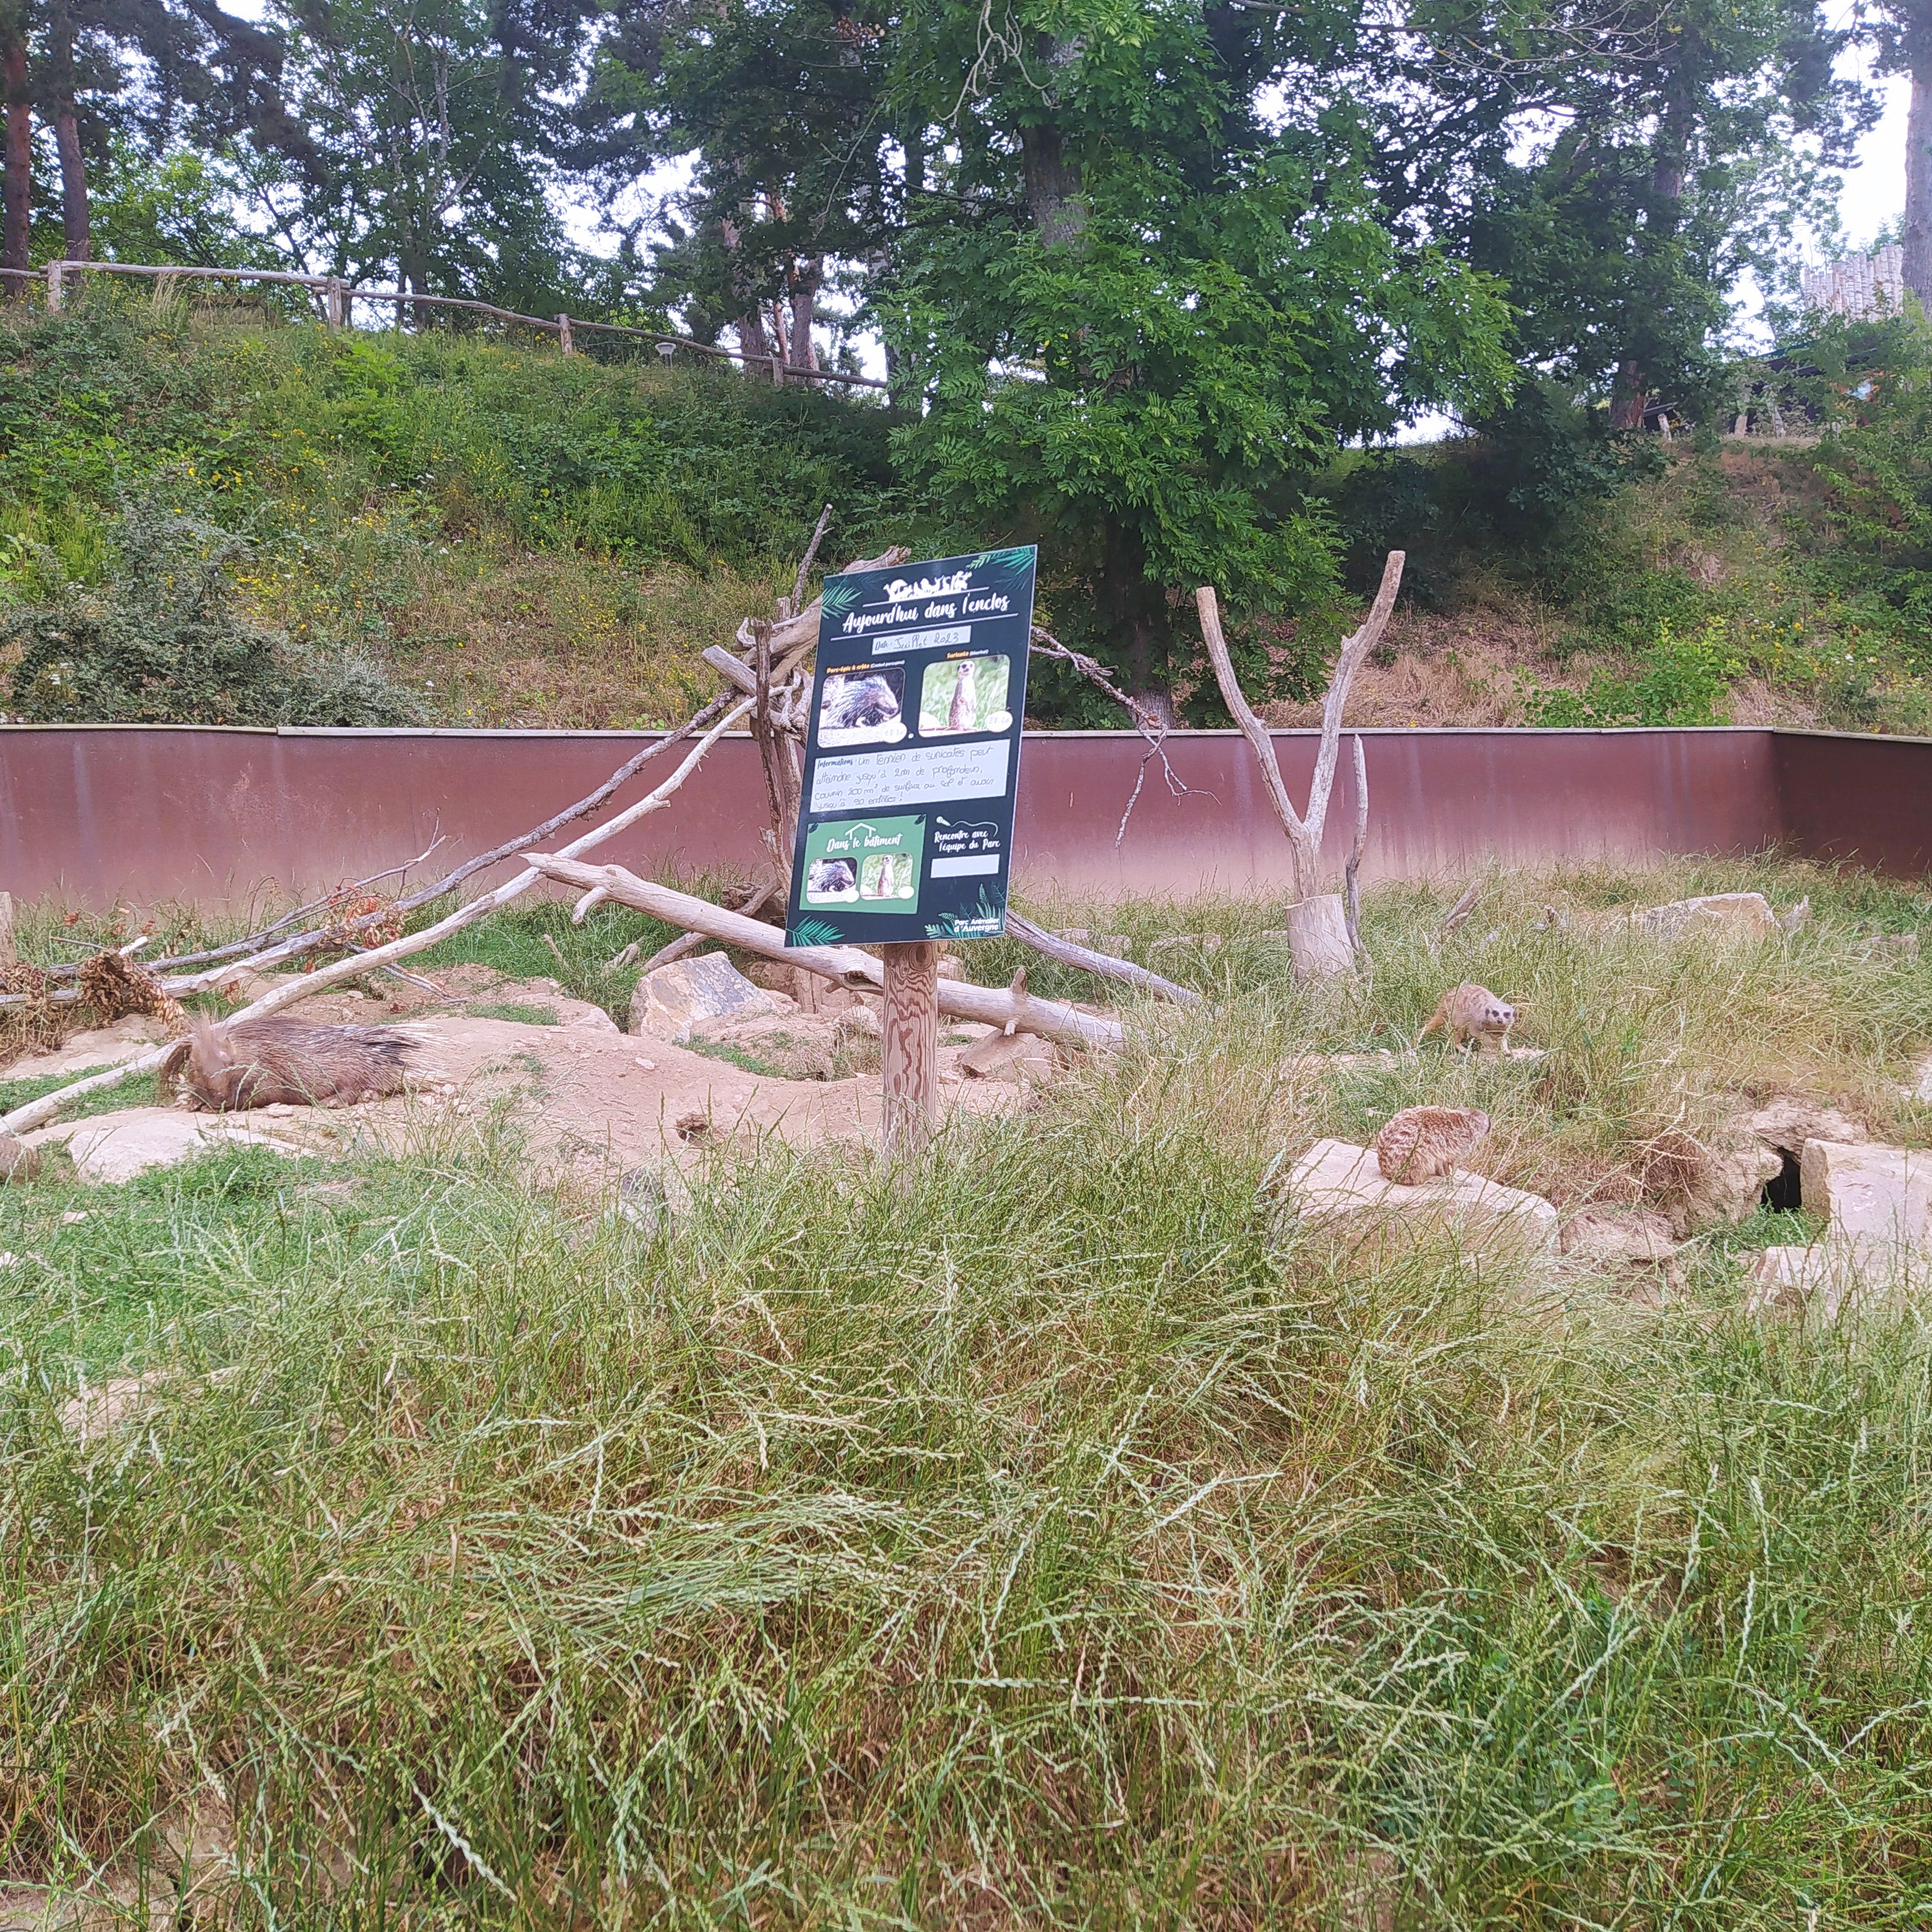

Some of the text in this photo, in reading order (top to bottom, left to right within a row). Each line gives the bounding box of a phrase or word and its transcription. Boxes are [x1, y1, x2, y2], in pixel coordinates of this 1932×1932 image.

[924, 601, 958, 618] dans
[962, 592, 1010, 615] l'enclos
[934, 632, 959, 643] 2023
[911, 752, 921, 762] de
[925, 747, 965, 761] suricates
[970, 744, 994, 761] peut
[816, 771, 851, 785] atteindre
[916, 766, 925, 776] de
[881, 784, 890, 793] de
[894, 780, 921, 791] surface
[940, 778, 954, 787] sol
[957, 776, 967, 786] et
[934, 829, 989, 843] Rencontre avec
[969, 839, 979, 849] du
[982, 838, 1001, 850] Parc
[826, 838, 850, 853] Dans
[853, 837, 861, 849] le
